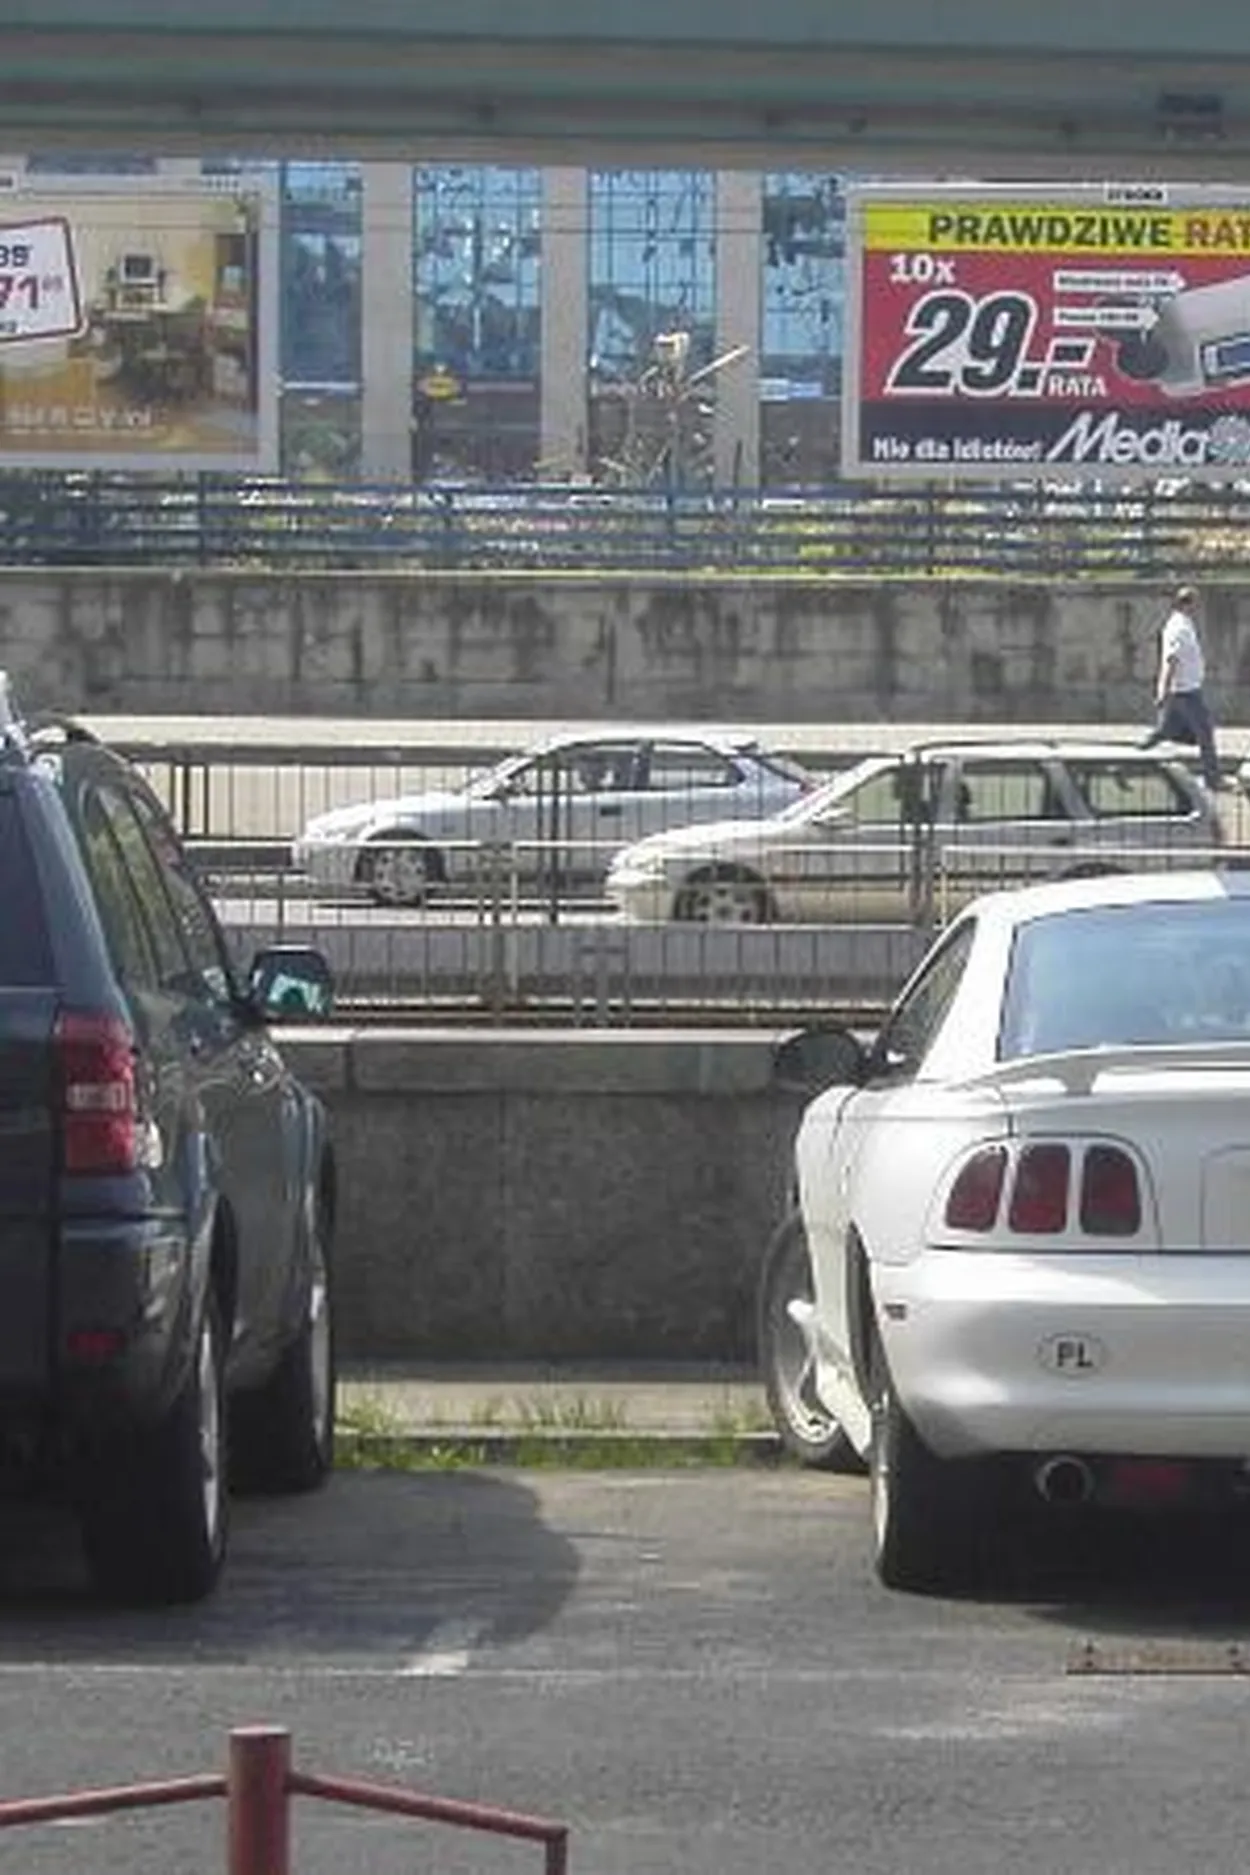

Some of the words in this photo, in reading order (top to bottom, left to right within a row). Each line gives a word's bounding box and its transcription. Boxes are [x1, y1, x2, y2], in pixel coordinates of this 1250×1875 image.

[928, 213, 1172, 247] PRAWDZIWE
[889, 252, 957, 284] 10x
[1048, 374, 1109, 398] RATA
[1046, 411, 1211, 464] Media
[1056, 1340, 1095, 1369] PL
